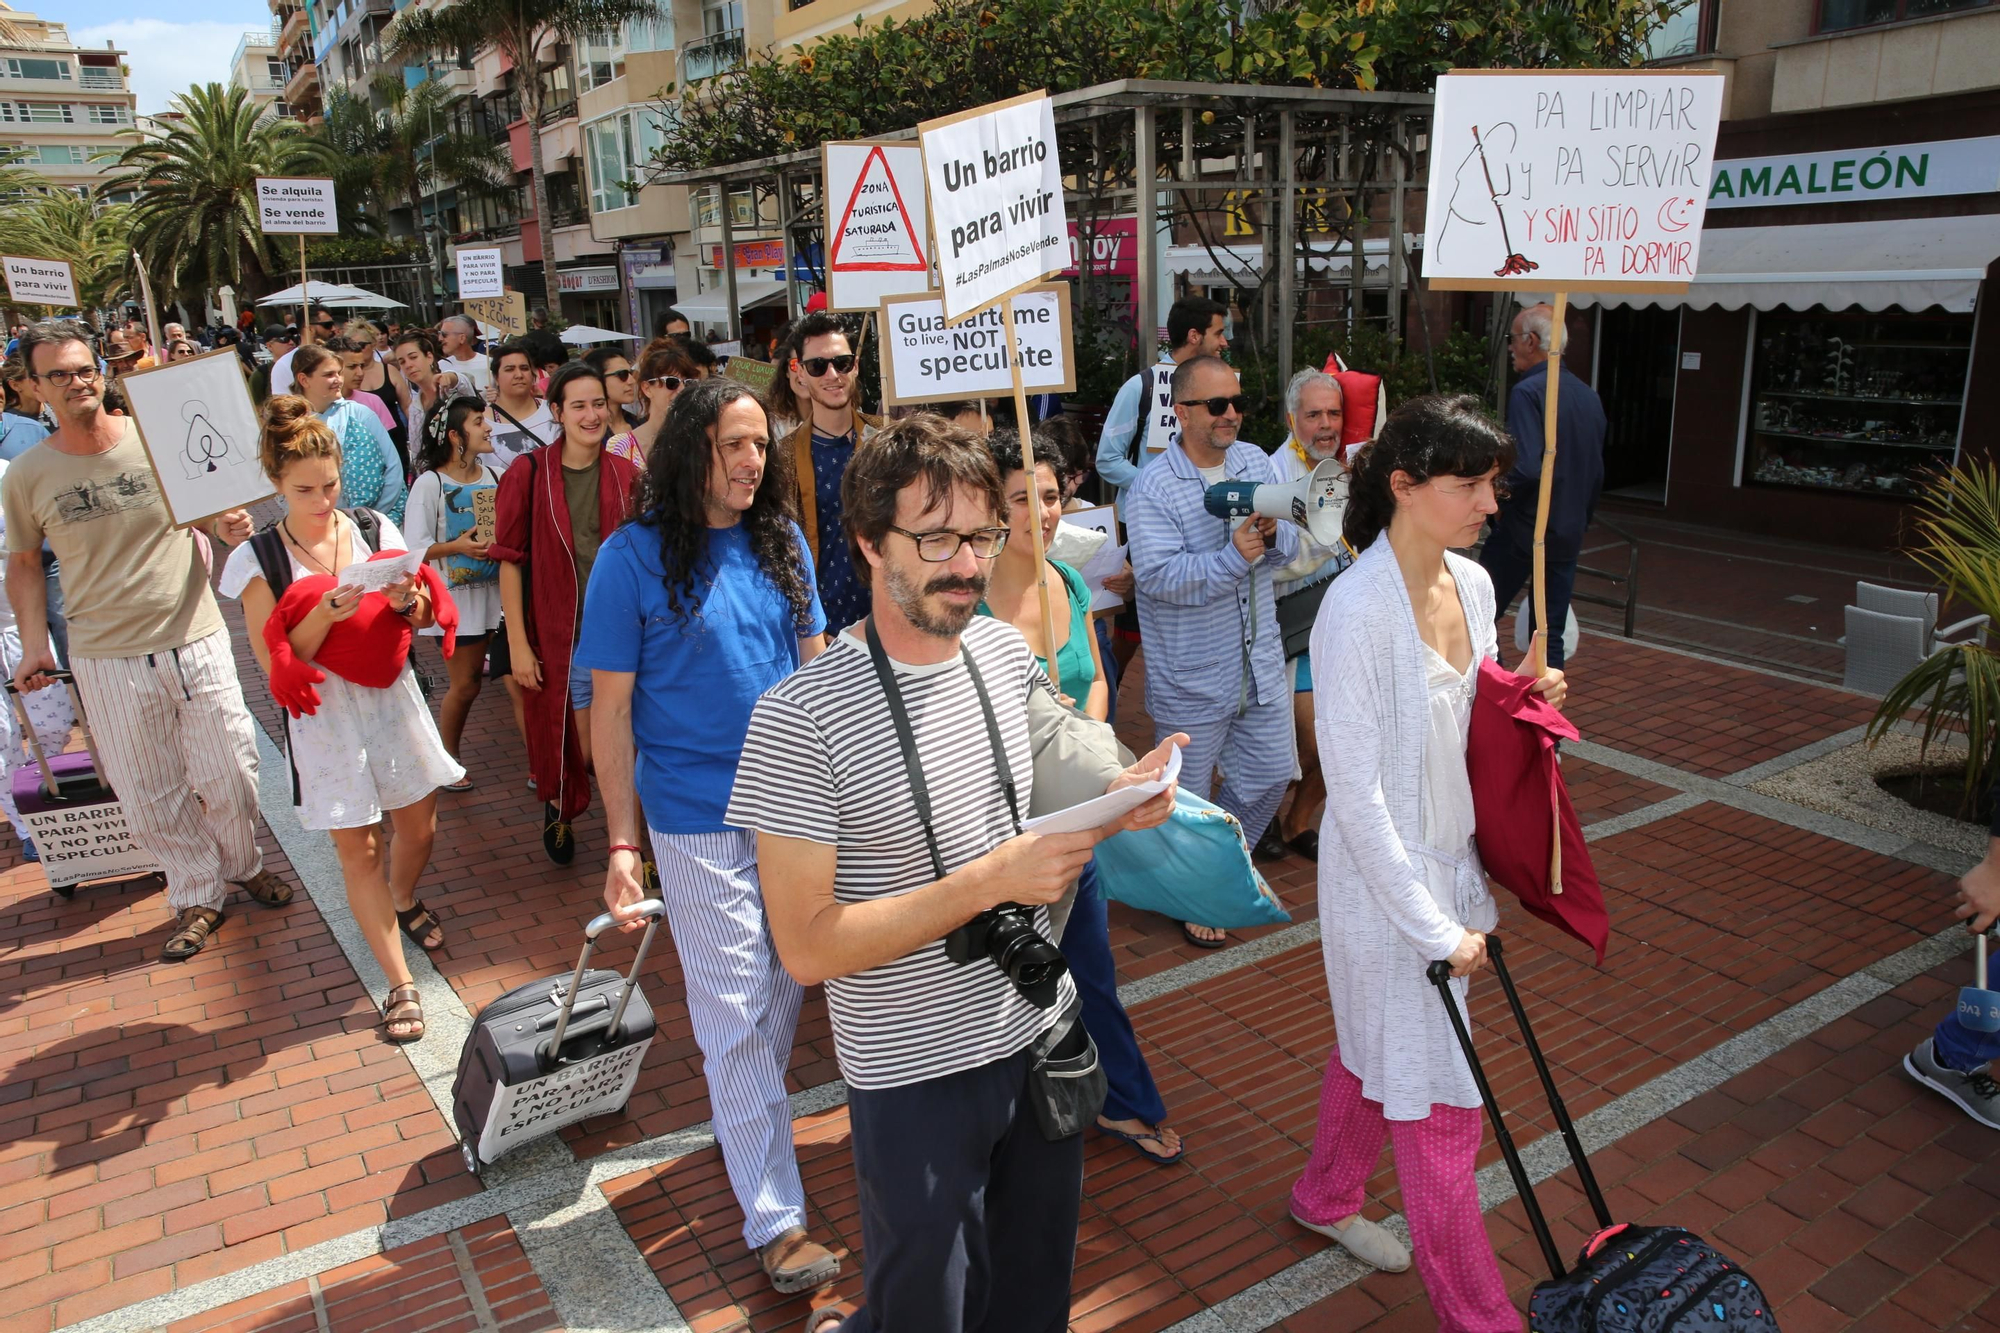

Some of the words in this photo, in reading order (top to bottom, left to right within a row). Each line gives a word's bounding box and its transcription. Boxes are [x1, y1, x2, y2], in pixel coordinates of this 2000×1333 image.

[1535, 91, 1565, 130] PA
[943, 159, 977, 193] Un
[983, 136, 1047, 180] barrio
[1555, 146, 1584, 186] PA
[1708, 150, 1929, 200] AMALEÓN
[262, 185, 278, 195] Se
[281, 186, 323, 197] alquila
[860, 181, 889, 194] ZONA
[264, 207, 281, 218] Se
[285, 208, 325, 218] vende
[851, 200, 899, 218] TURÍSTICA
[844, 220, 897, 237] SATURADA
[951, 210, 1003, 259] para
[1007, 188, 1054, 226] vivir
[1523, 208, 1538, 242] Y
[11, 264, 27, 274] Un
[30, 266, 65, 278] barrio
[956, 234, 1059, 288] #LasPalmasNoSeVende
[1584, 246, 1605, 276] PA
[14, 280, 40, 289] para
[43, 281, 68, 291] vivir
[464, 277, 498, 285] ESPECULAR
[903, 335, 918, 347] to
[921, 333, 949, 346] live,
[953, 329, 999, 351] NOT
[731, 359, 750, 372] YOUR
[752, 363, 777, 376] LUXUR
[920, 344, 1053, 381] speculte
[1160, 414, 1178, 429] EN
[30, 814, 58, 827] UN
[64, 805, 123, 823] BARRI
[37, 824, 89, 840] PARA
[92, 819, 127, 831] VIVI
[42, 841, 54, 851] Y
[61, 837, 89, 849] NO
[95, 831, 131, 844] PAR
[45, 843, 143, 864] ESPECULA
[51, 862, 160, 884] #LasPalmasNoSeVende
[516, 1077, 549, 1096] UN
[556, 1045, 642, 1083] BARRIO
[512, 1084, 572, 1108] PARA
[581, 1057, 633, 1086] VIVIR
[509, 1109, 523, 1121] Y
[529, 1096, 563, 1114] NO
[570, 1072, 624, 1100] PARA
[499, 1082, 623, 1138] ESPECULAR
